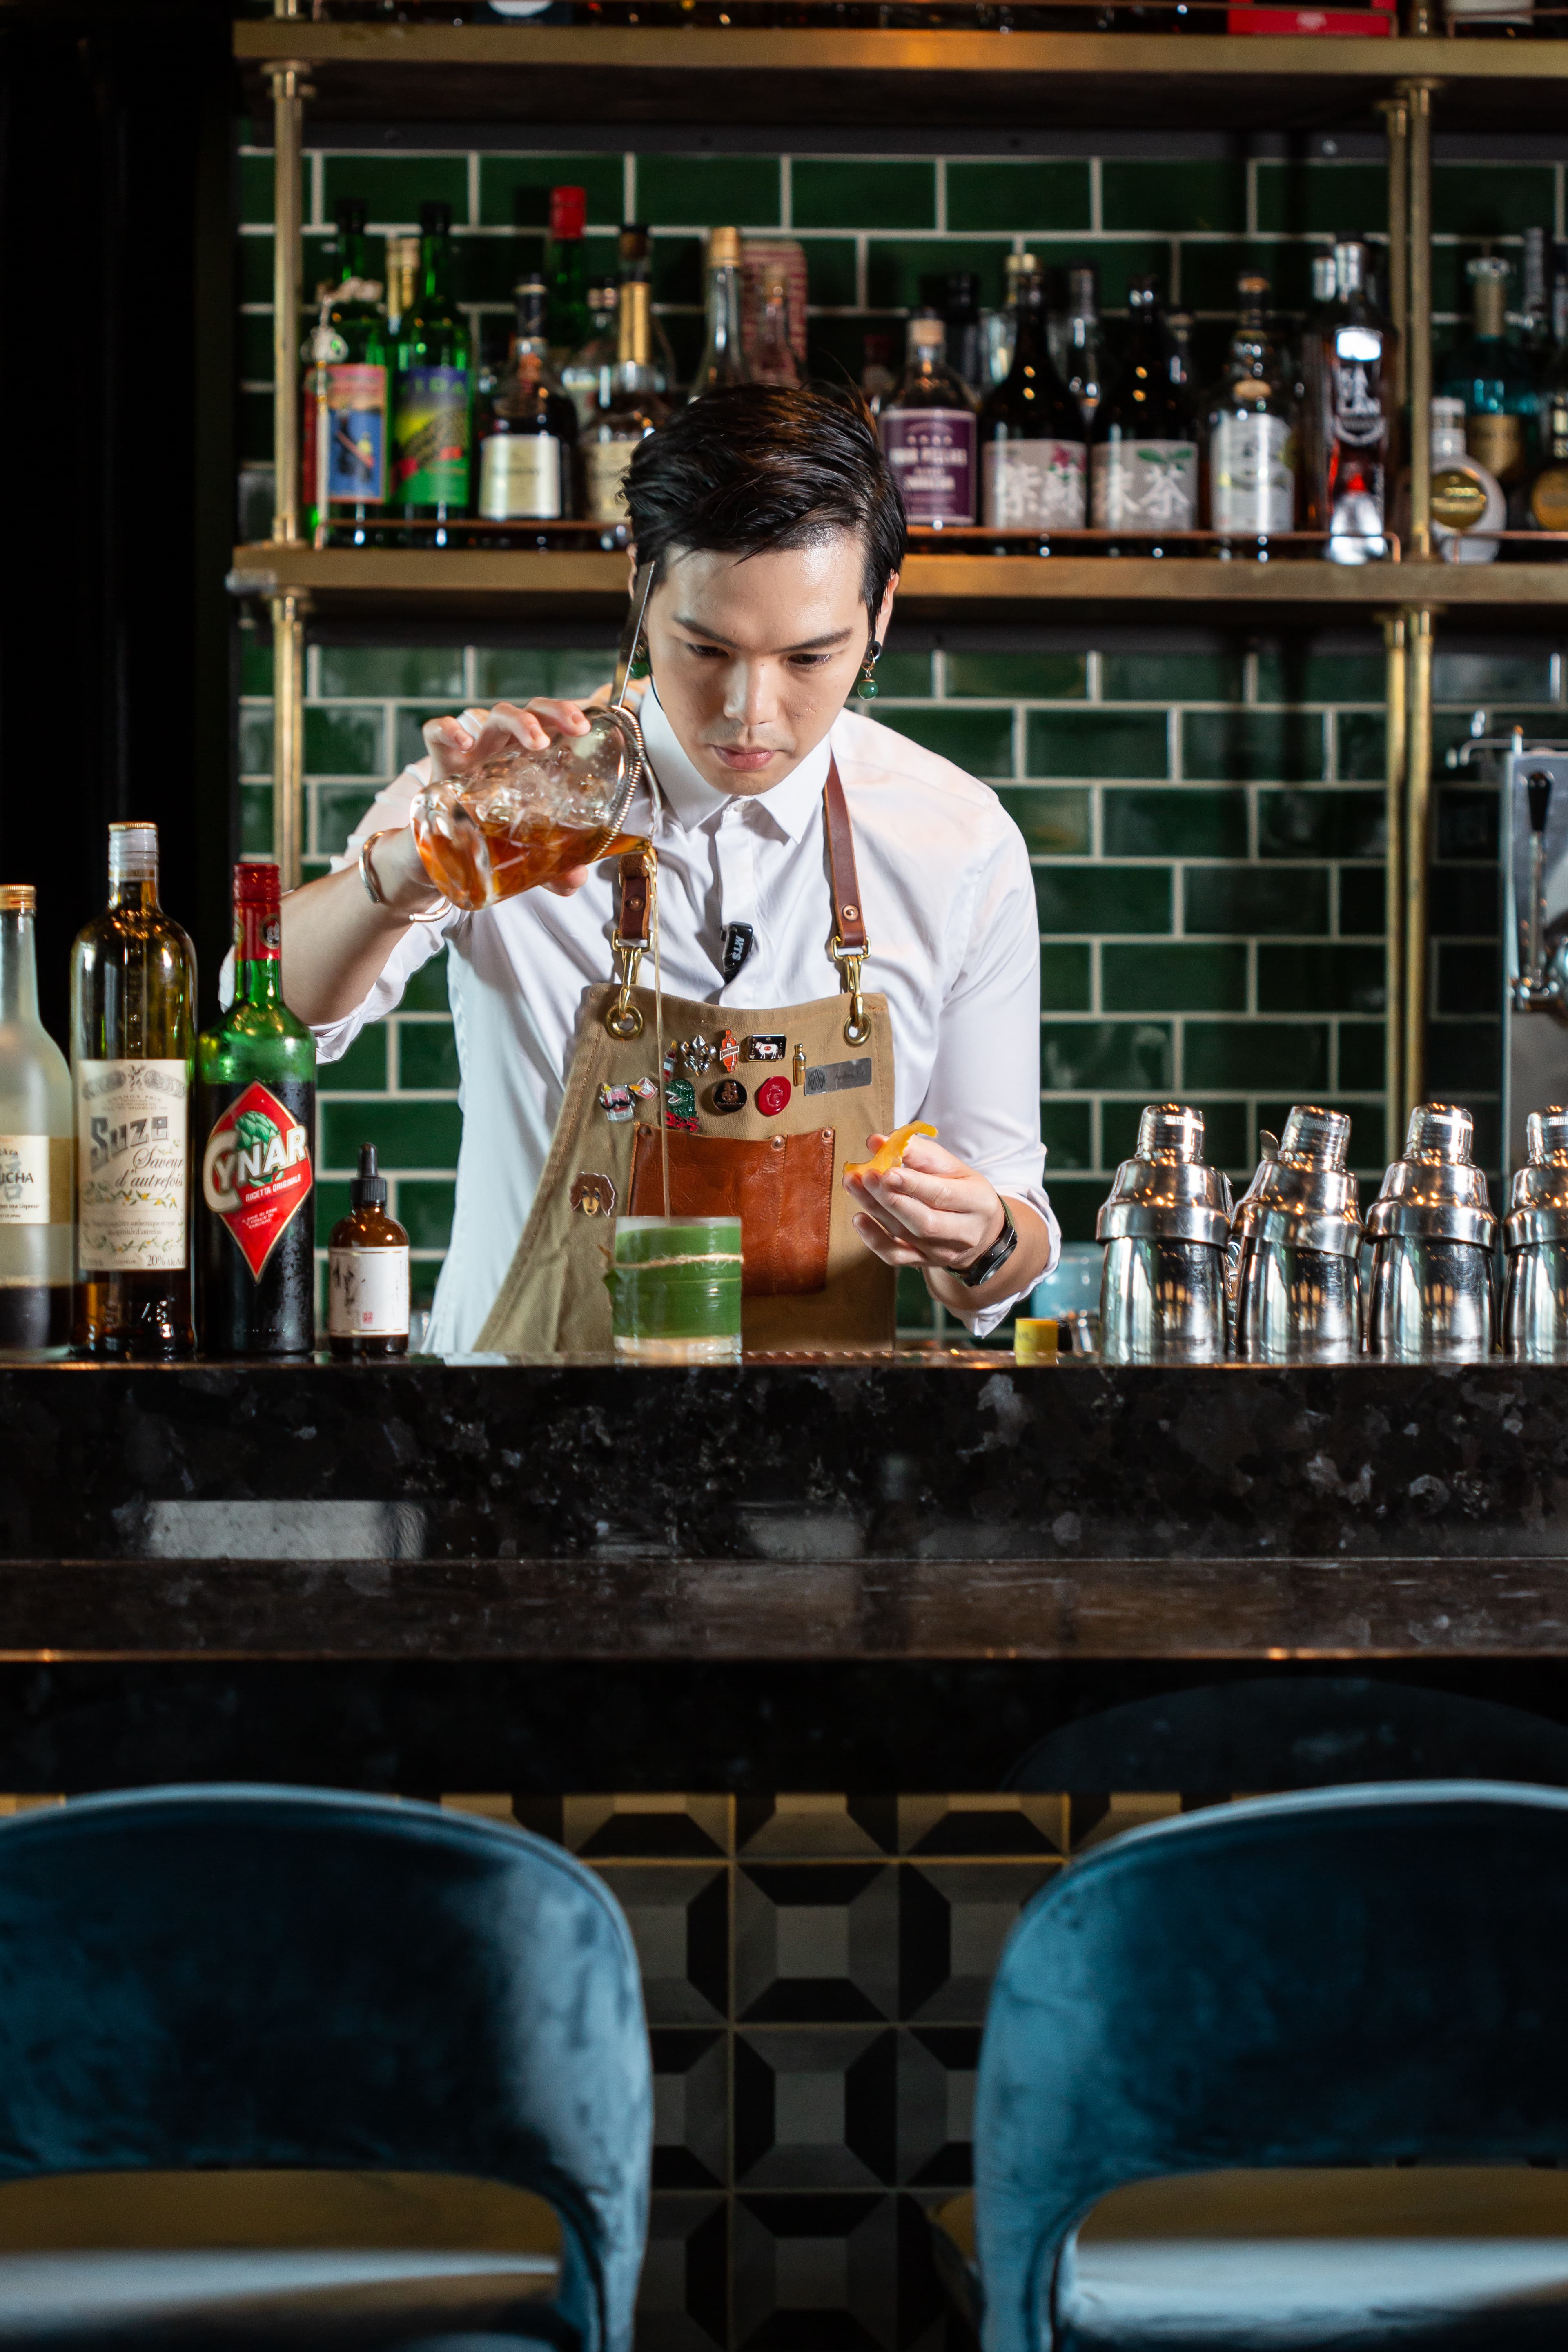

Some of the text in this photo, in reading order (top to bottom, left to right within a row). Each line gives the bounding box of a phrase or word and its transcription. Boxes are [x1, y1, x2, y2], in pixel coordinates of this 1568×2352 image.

[133, 1146, 183, 1171] Saveur
[203, 1125, 307, 1213] CYNAR
[115, 1169, 183, 1195] d'autrefois
[245, 1173, 301, 1203] RICETTA ORIGINALE
[130, 1219, 160, 1228] authentique
[147, 1254, 165, 1266] 20%
